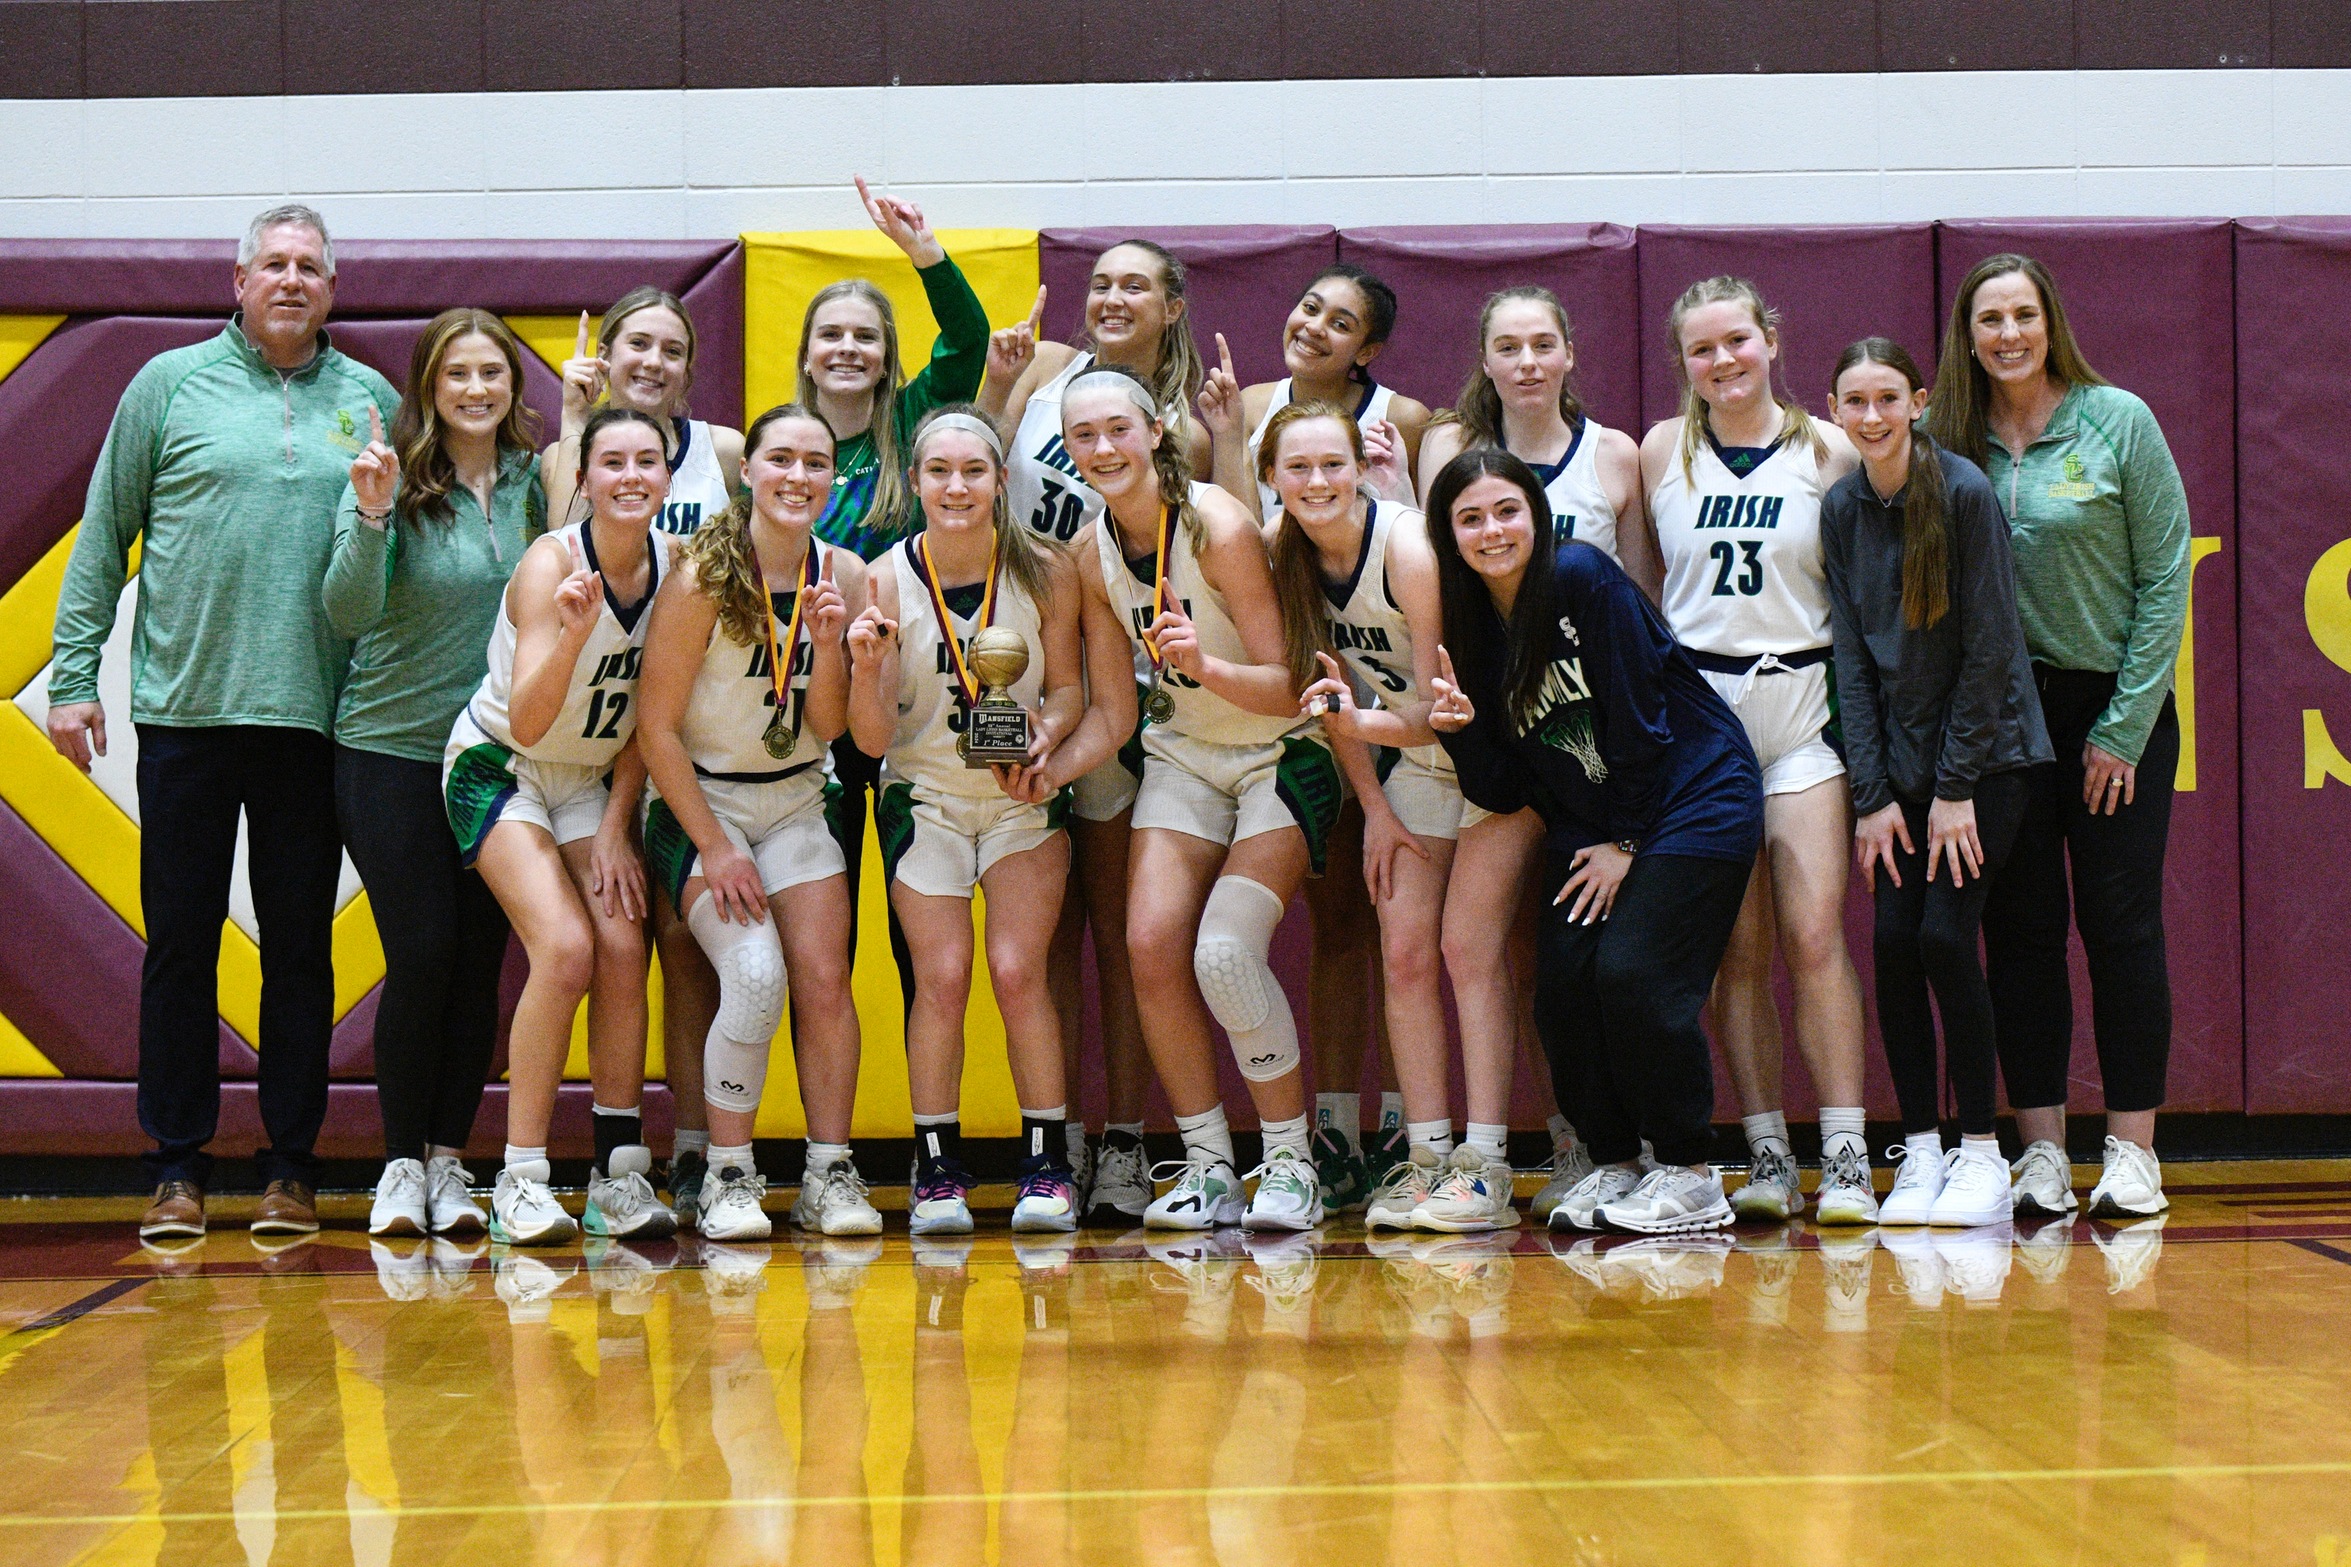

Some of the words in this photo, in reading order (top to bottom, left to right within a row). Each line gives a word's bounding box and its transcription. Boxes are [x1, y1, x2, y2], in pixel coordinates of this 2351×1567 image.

[655, 502, 701, 535] ISH
[1031, 477, 1084, 542] 30
[1694, 495, 1784, 530] IRISH
[1710, 540, 1764, 596] 23
[581, 689, 629, 738] 12
[979, 713, 1021, 724] MANSFIELD
[992, 739, 1013, 747] Place
